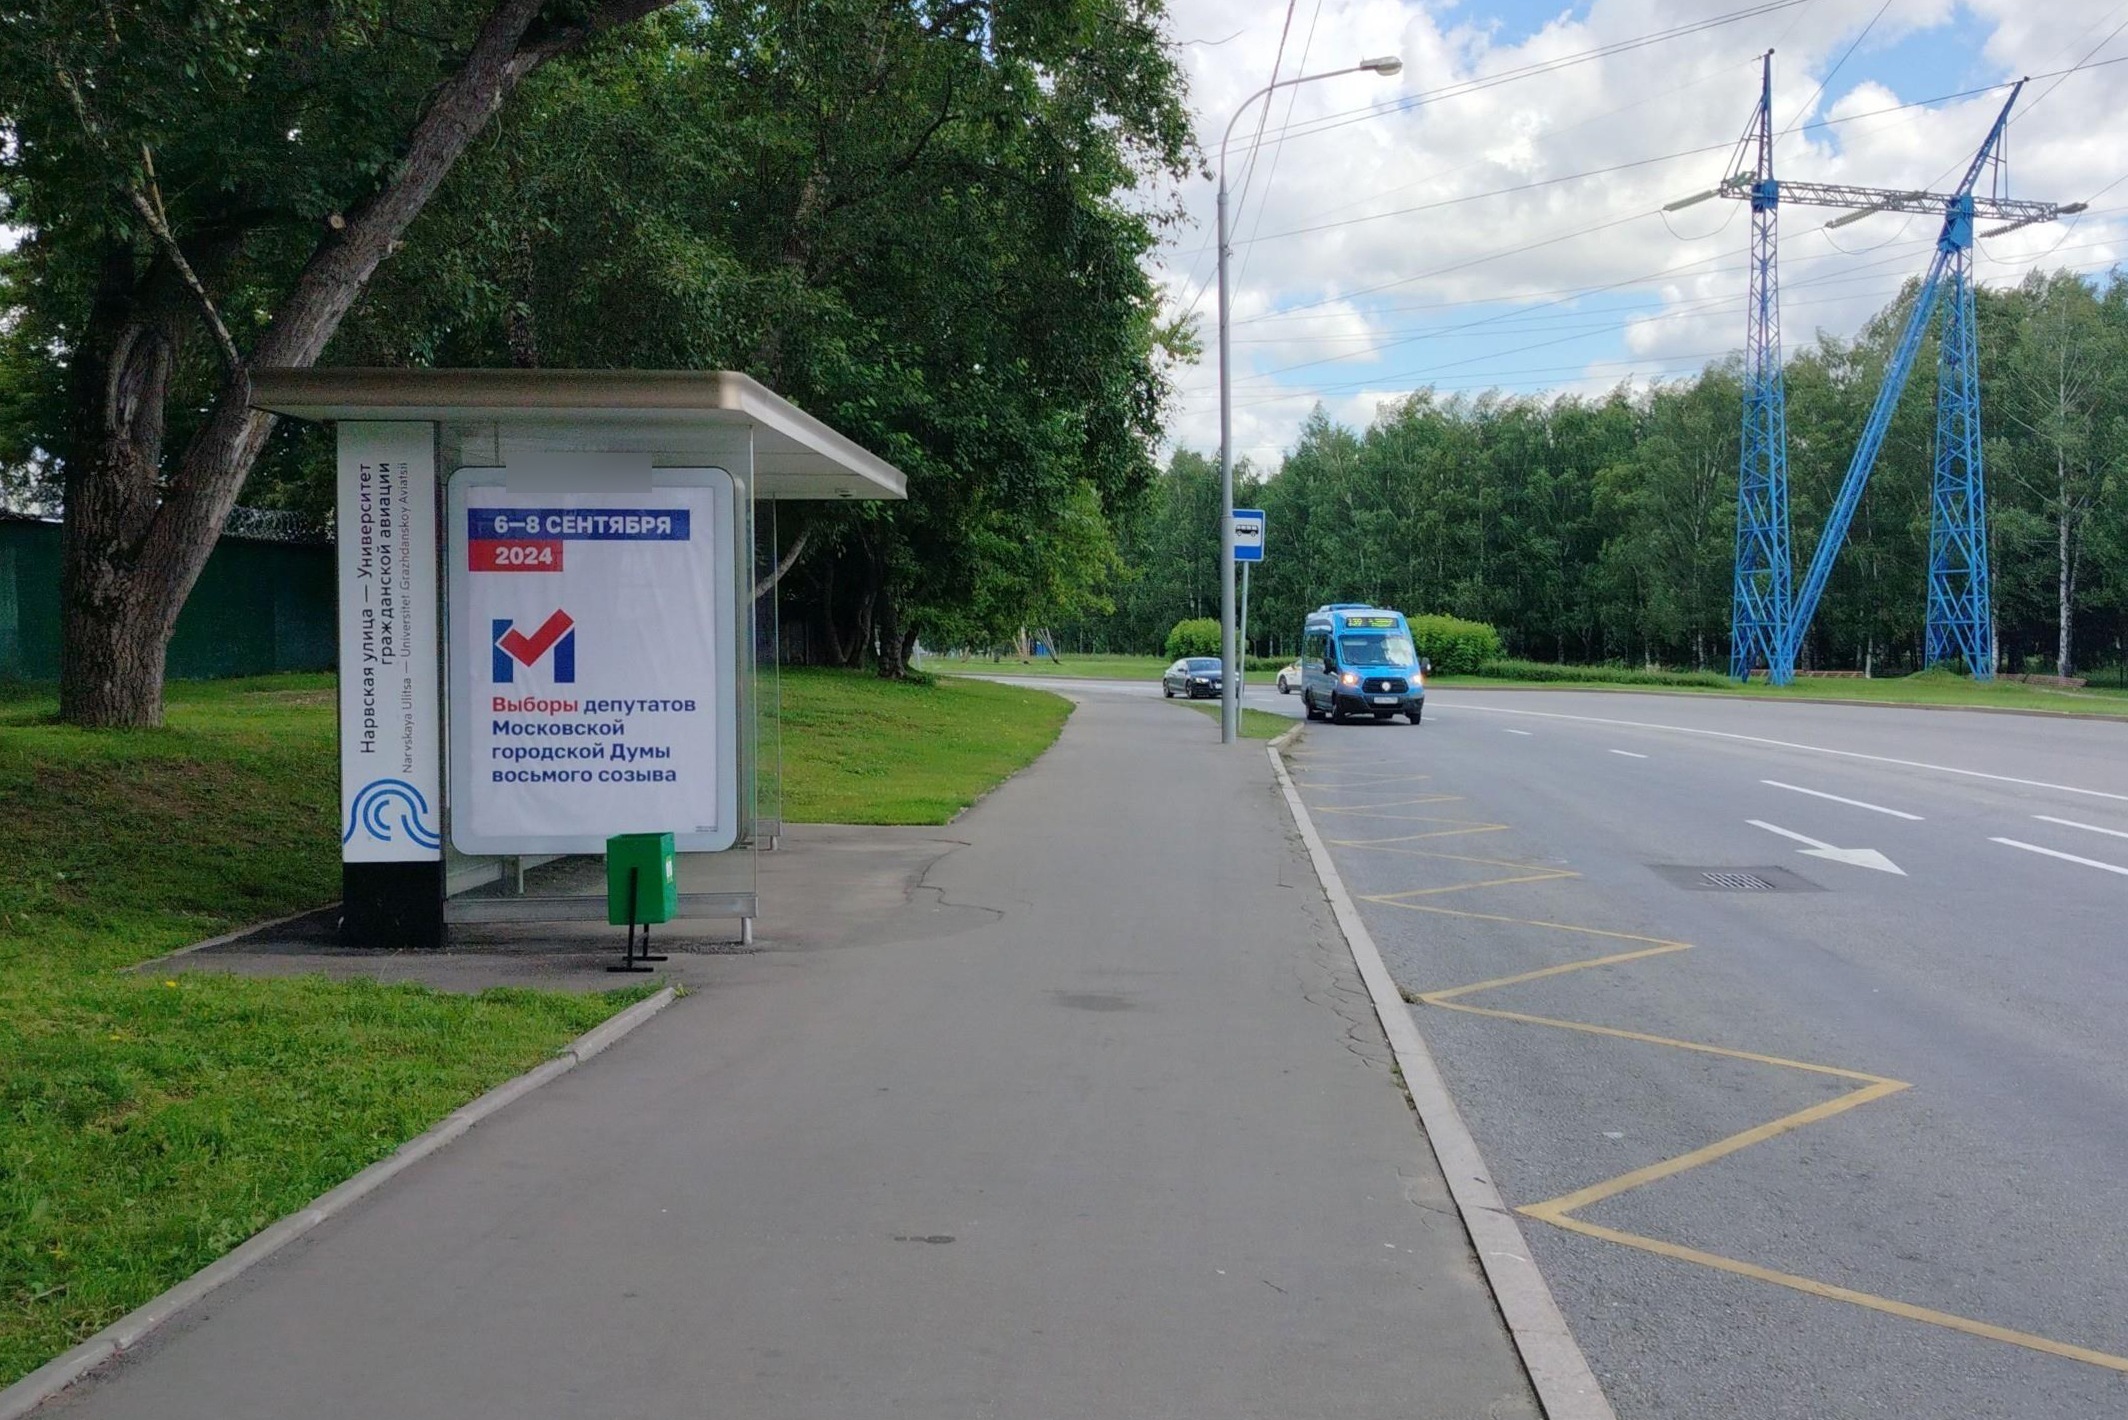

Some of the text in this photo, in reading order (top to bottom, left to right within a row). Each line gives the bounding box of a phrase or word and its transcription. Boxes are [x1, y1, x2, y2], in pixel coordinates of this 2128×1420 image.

[397, 462, 409, 504] Aviatsii
[357, 463, 375, 579] Университет
[545, 515, 672, 535] СЕНТЯБРЯ
[376, 462, 395, 666] гражданской авиации
[398, 507, 413, 591] Grazhdanskoy
[494, 547, 553, 565] 2024
[361, 608, 378, 663] улица
[399, 595, 411, 658] Universitet
[360, 667, 378, 754] Нарвская
[400, 677, 412, 710] Ulitsa
[492, 697, 696, 717] Выборы депутатов
[401, 713, 415, 774] Narvskaya
[492, 718, 625, 736] Московской
[492, 741, 671, 762] городской Думы
[492, 767, 677, 785] восьмого созыва
